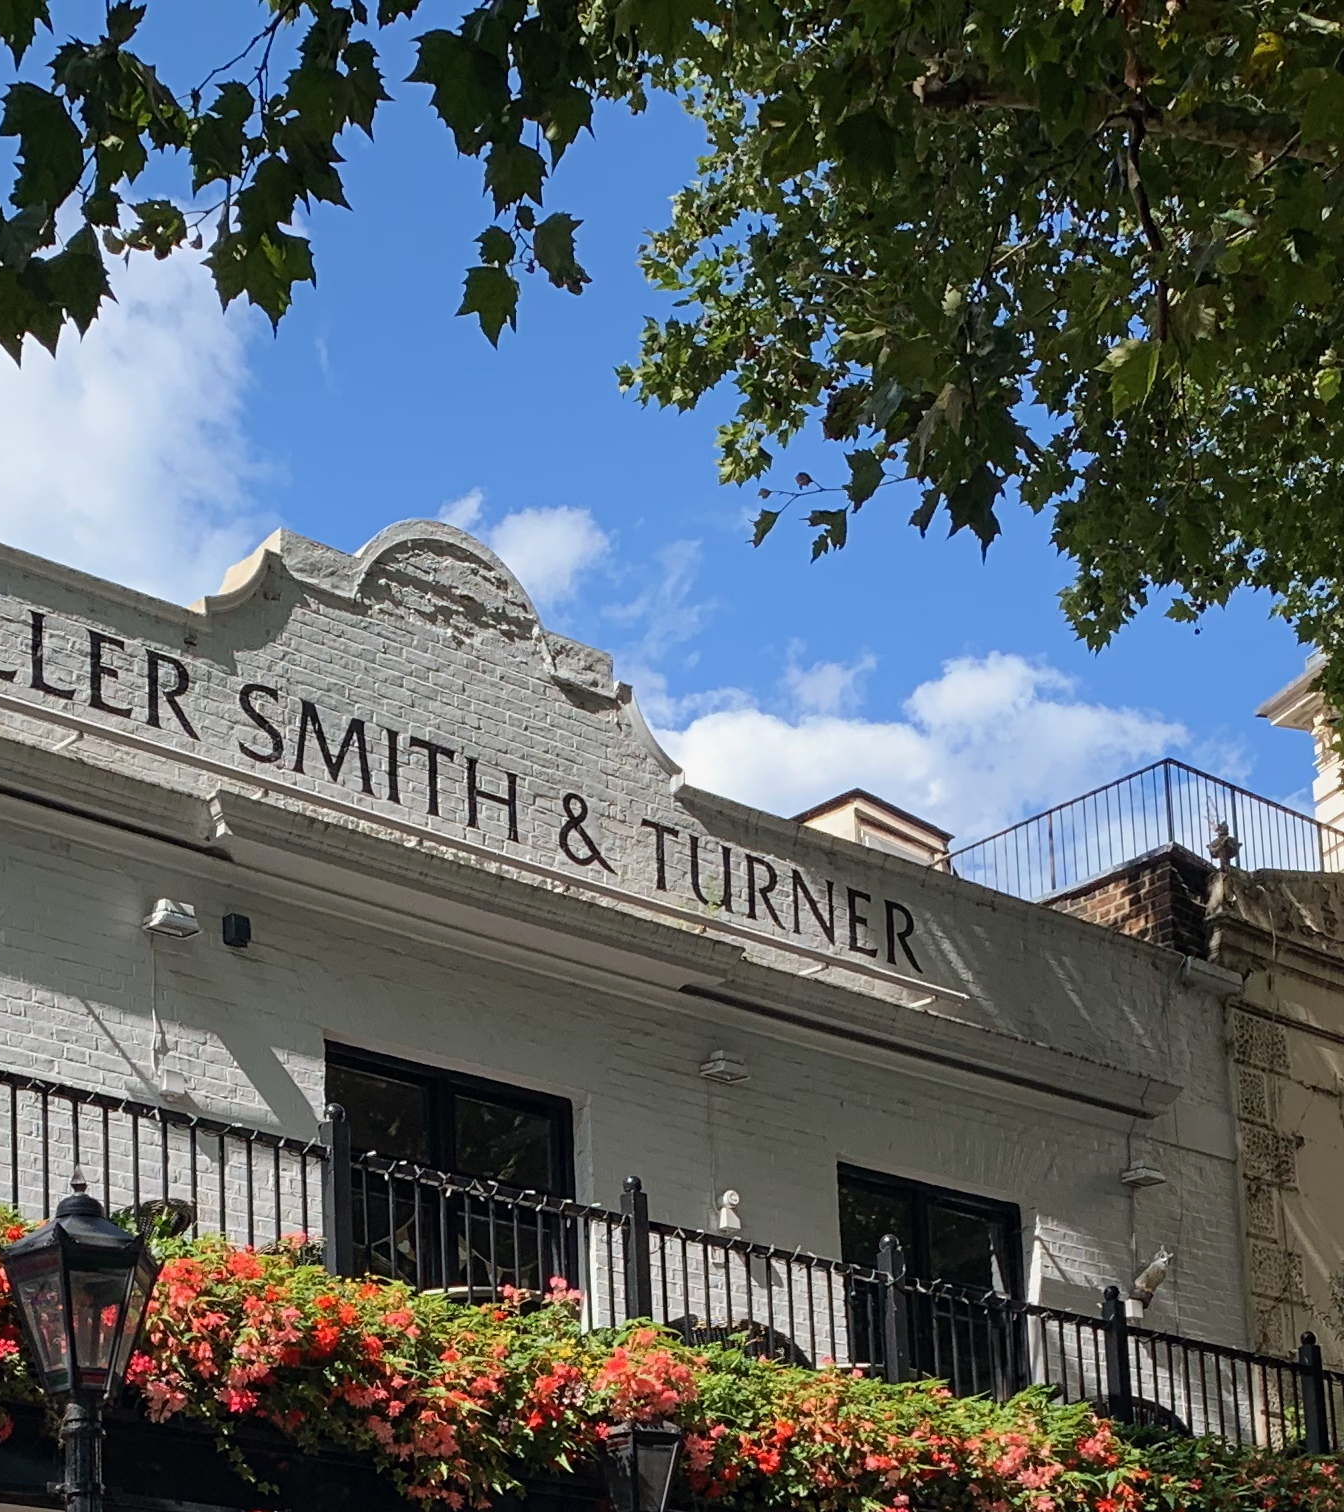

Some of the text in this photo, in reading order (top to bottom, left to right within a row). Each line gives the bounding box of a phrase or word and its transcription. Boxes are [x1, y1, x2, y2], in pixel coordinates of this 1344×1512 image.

[238, 681, 520, 843] SMITH
[559, 792, 616, 874] &
[641, 818, 924, 973] TURNER
